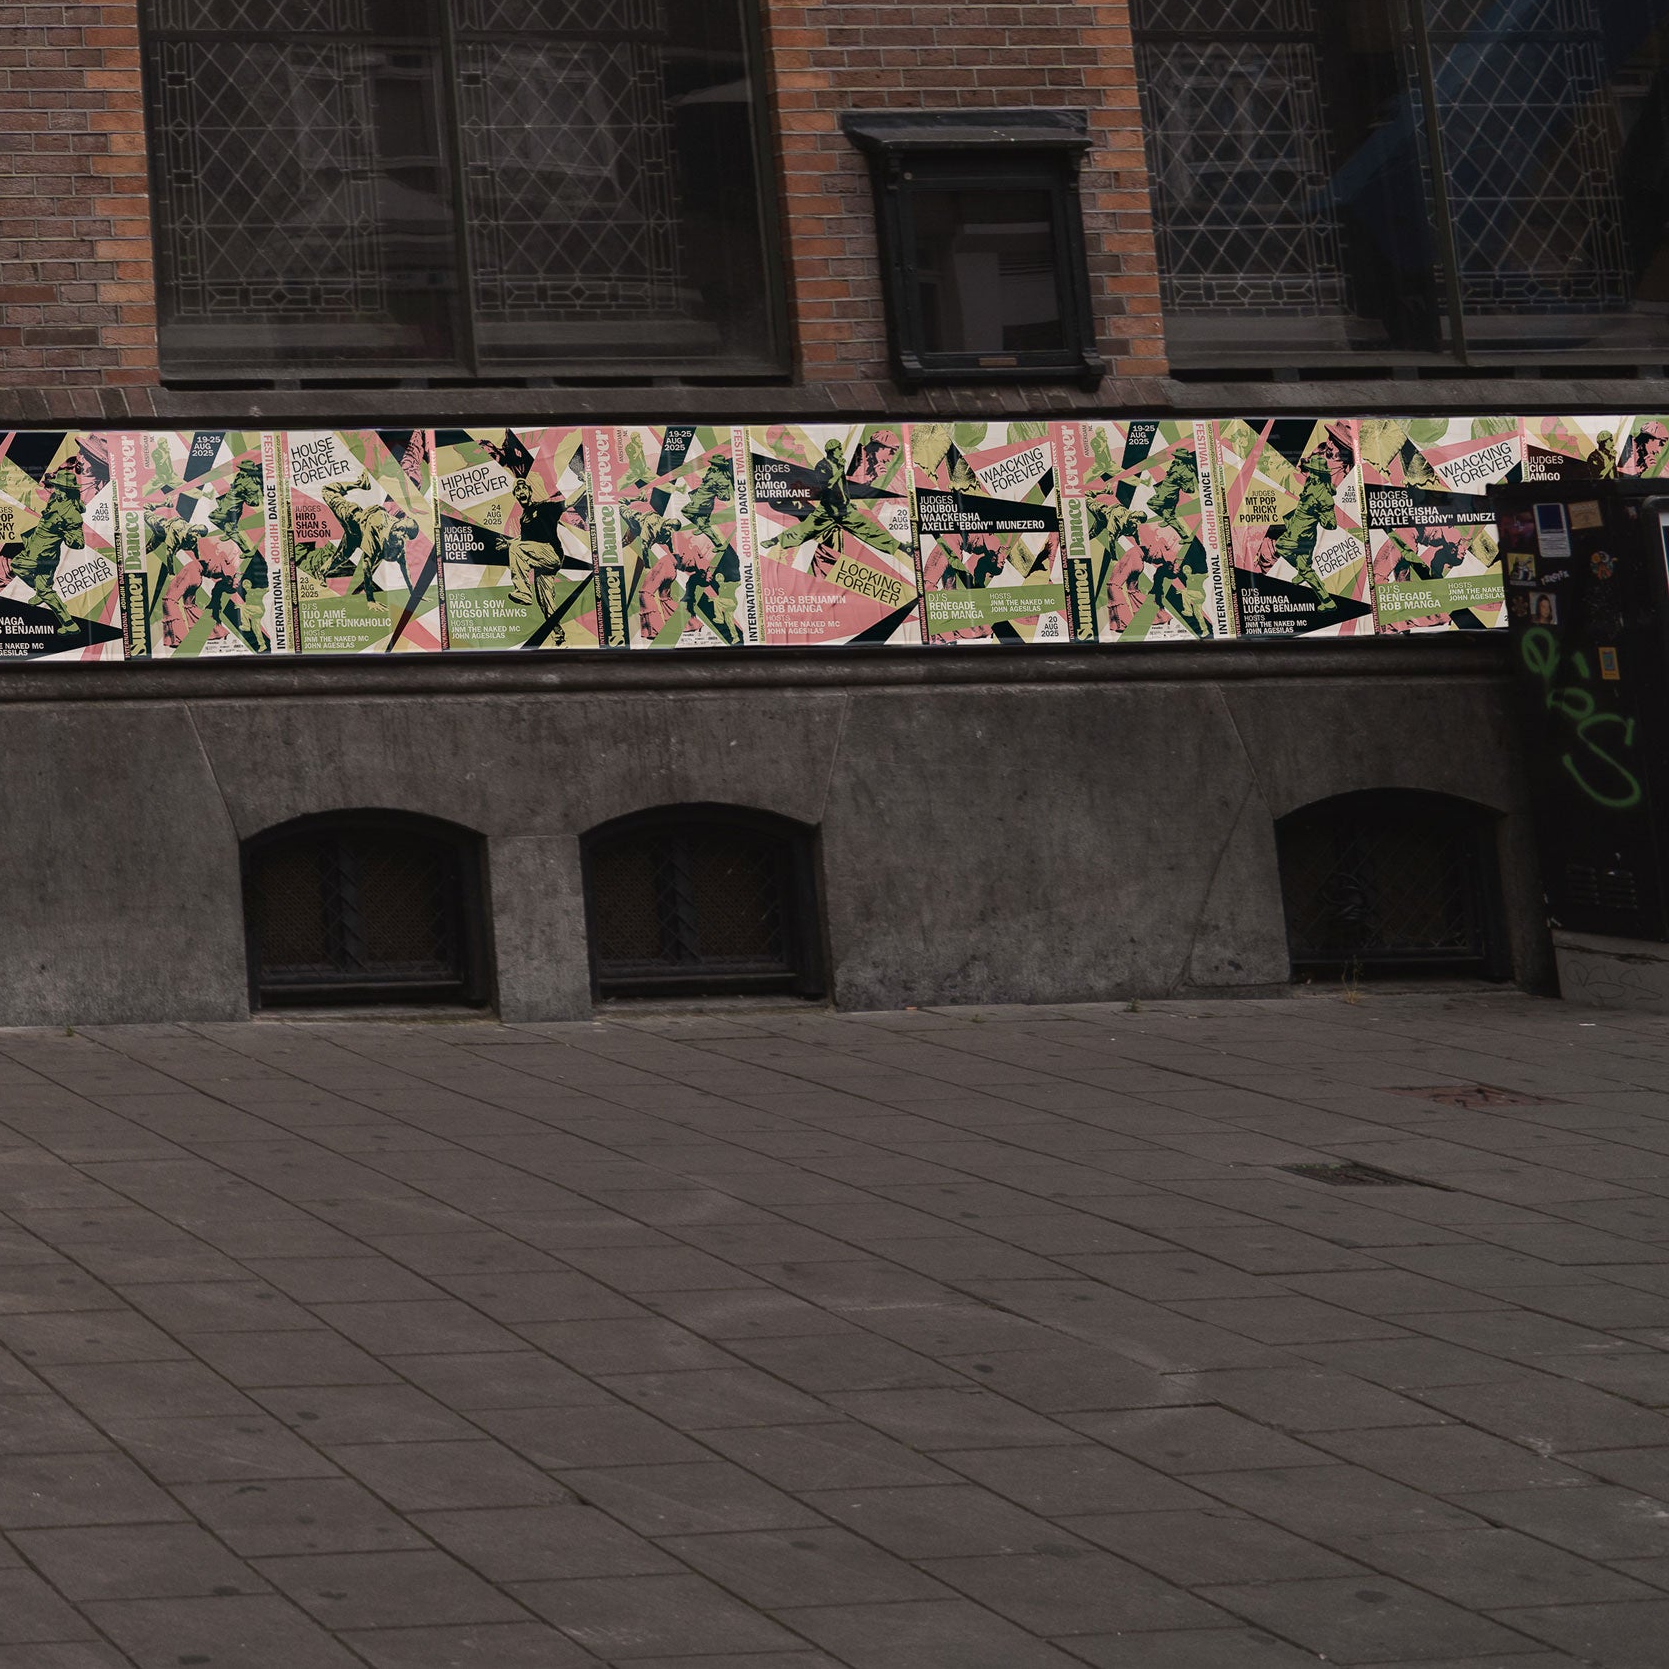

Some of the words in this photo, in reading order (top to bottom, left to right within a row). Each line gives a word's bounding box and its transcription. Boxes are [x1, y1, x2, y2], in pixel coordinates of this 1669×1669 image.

[192, 449, 215, 457] 2025
[263, 435, 275, 482] FESTIVAL
[291, 436, 335, 461] HOUSE
[291, 450, 334, 474] DANCE
[734, 429, 745, 475] FESTIVAL
[1061, 424, 1080, 497] Forever
[1195, 423, 1209, 469] FESTIVAL
[1439, 441, 1512, 478] WAACKING
[1529, 456, 1564, 465] JUDGES
[120, 434, 141, 510] Forever
[292, 460, 351, 487] FOREVER
[440, 466, 491, 491] HIPHOP
[595, 429, 612, 504] Forever
[755, 464, 791, 473] JUDGES
[755, 473, 771, 481] CIO
[979, 447, 1044, 484] WAACKING
[991, 460, 1047, 493] FOREVER
[1452, 455, 1515, 487] FOREVER
[1530, 464, 1546, 473] CIO
[1530, 472, 1561, 481] AMIGO
[448, 475, 509, 502] FOREVER
[738, 478, 748, 514] DANCE
[755, 481, 787, 490] AMIGO
[756, 489, 811, 498] HURRIKANE
[1202, 472, 1213, 507] DANCE
[269, 484, 279, 520] DANCE
[920, 504, 958, 513] BOUBOU
[920, 512, 981, 522] WAACKEISHA
[1370, 499, 1413, 508] BOUBOU
[1370, 507, 1439, 517] WAACKEISHA
[8, 531, 16, 541] C
[601, 505, 618, 564] Dance
[921, 521, 955, 531] AXELLE
[996, 520, 1045, 530] MUNEZERO
[1068, 498, 1086, 556] Dance
[1208, 510, 1218, 550] HIPHOP
[1370, 517, 1409, 526] AXELLE
[125, 511, 143, 571] Dance
[269, 523, 281, 564] HIPHOP
[444, 534, 474, 543] MAJID
[445, 542, 485, 551] BOUBOO
[740, 518, 751, 558] HIPHOP
[1314, 536, 1357, 566] POPPING
[445, 551, 468, 560] ICEE
[1318, 546, 1362, 577] FOREVER
[56, 556, 108, 588] POPPING
[60, 567, 114, 599] FOREVER
[839, 560, 903, 595] LOCKING
[744, 562, 758, 642] INTERNATIONAL
[835, 571, 900, 607] FOREVER
[1073, 559, 1093, 640] Summer
[1211, 554, 1228, 635] INTERNATIONAL
[127, 572, 147, 656] Summer
[271, 568, 287, 650] INTERNATIONAL
[606, 566, 626, 647] Summer
[4, 625, 55, 635] BENJAMIN
[303, 620, 315, 628] KC
[317, 619, 334, 628] THE
[336, 618, 392, 628] FUNKAHOLIC
